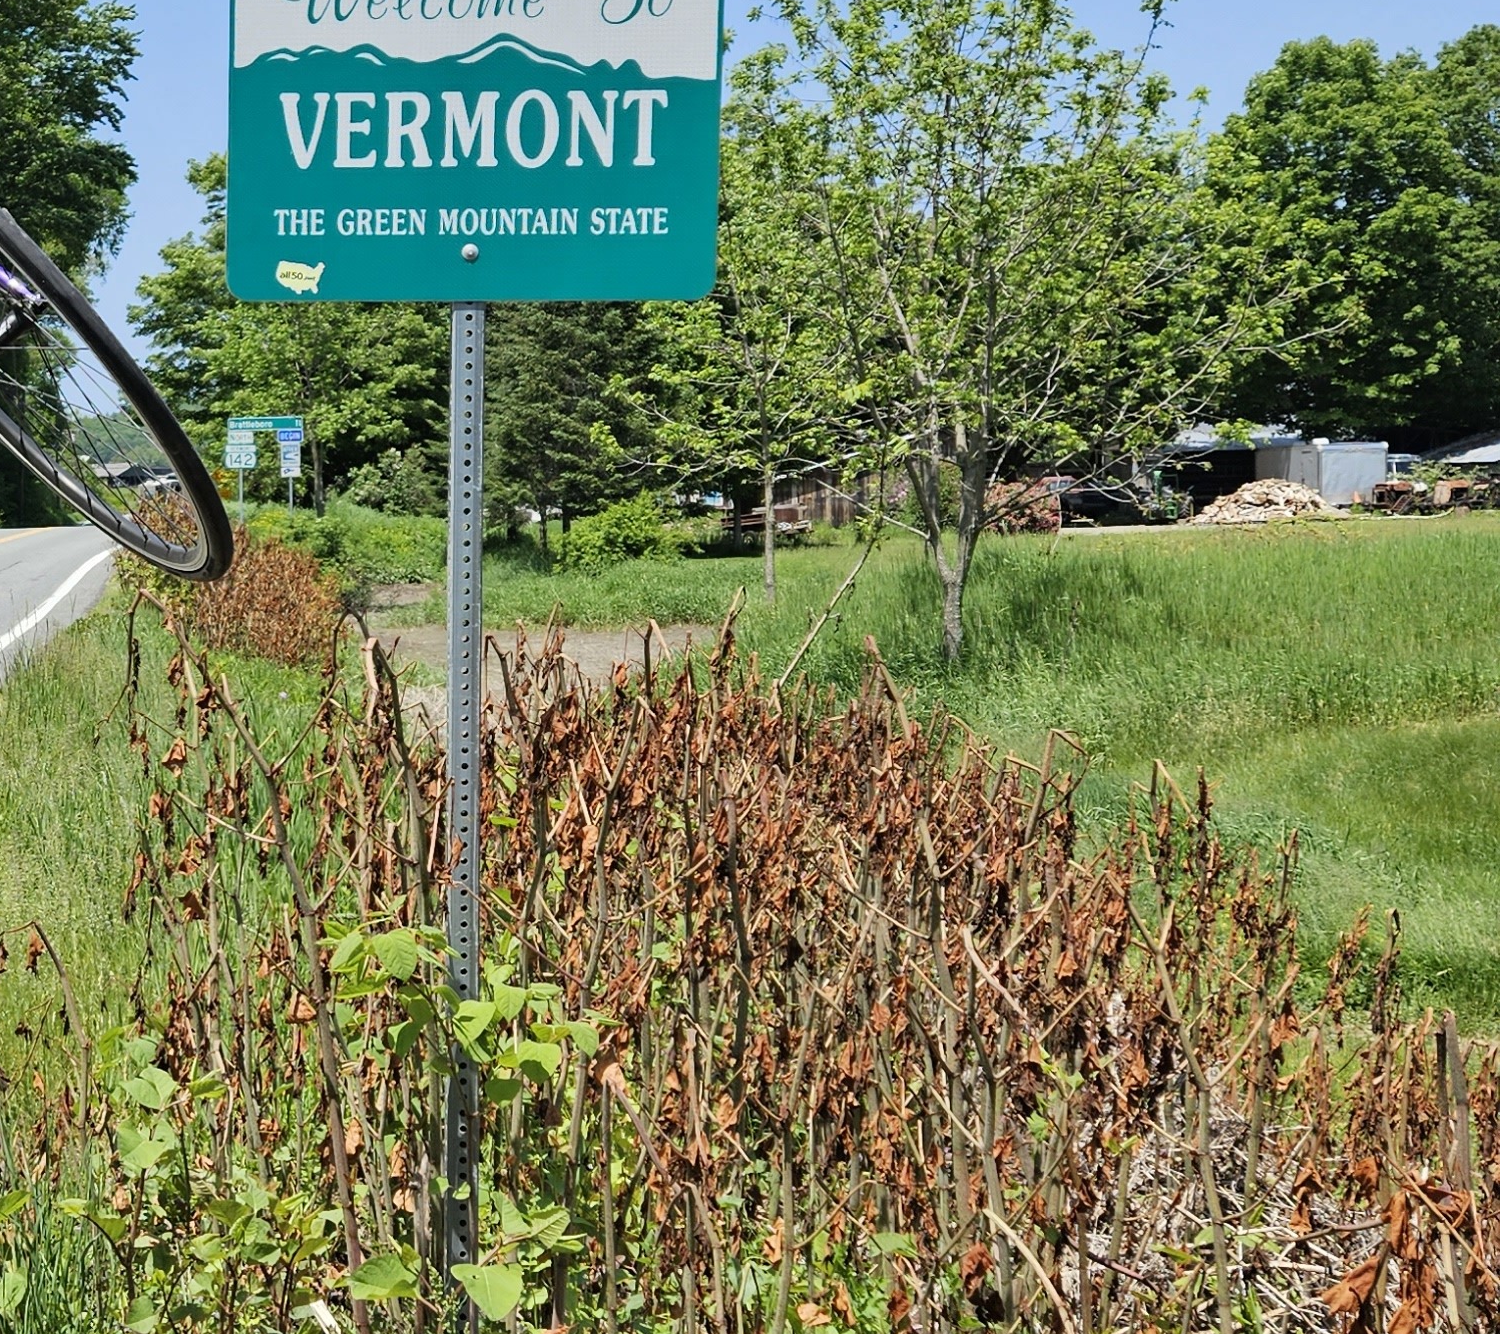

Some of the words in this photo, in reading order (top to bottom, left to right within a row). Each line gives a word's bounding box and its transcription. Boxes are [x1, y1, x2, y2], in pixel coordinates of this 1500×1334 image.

[279, 89, 668, 170] VERMONT
[274, 208, 326, 236] THE
[337, 208, 427, 236] GREEN
[438, 207, 579, 235] MOUNTAIN
[590, 207, 669, 235] STATE
[229, 420, 273, 428] Brattleboro
[280, 432, 301, 441] BEGIN
[229, 453, 253, 466] 142
